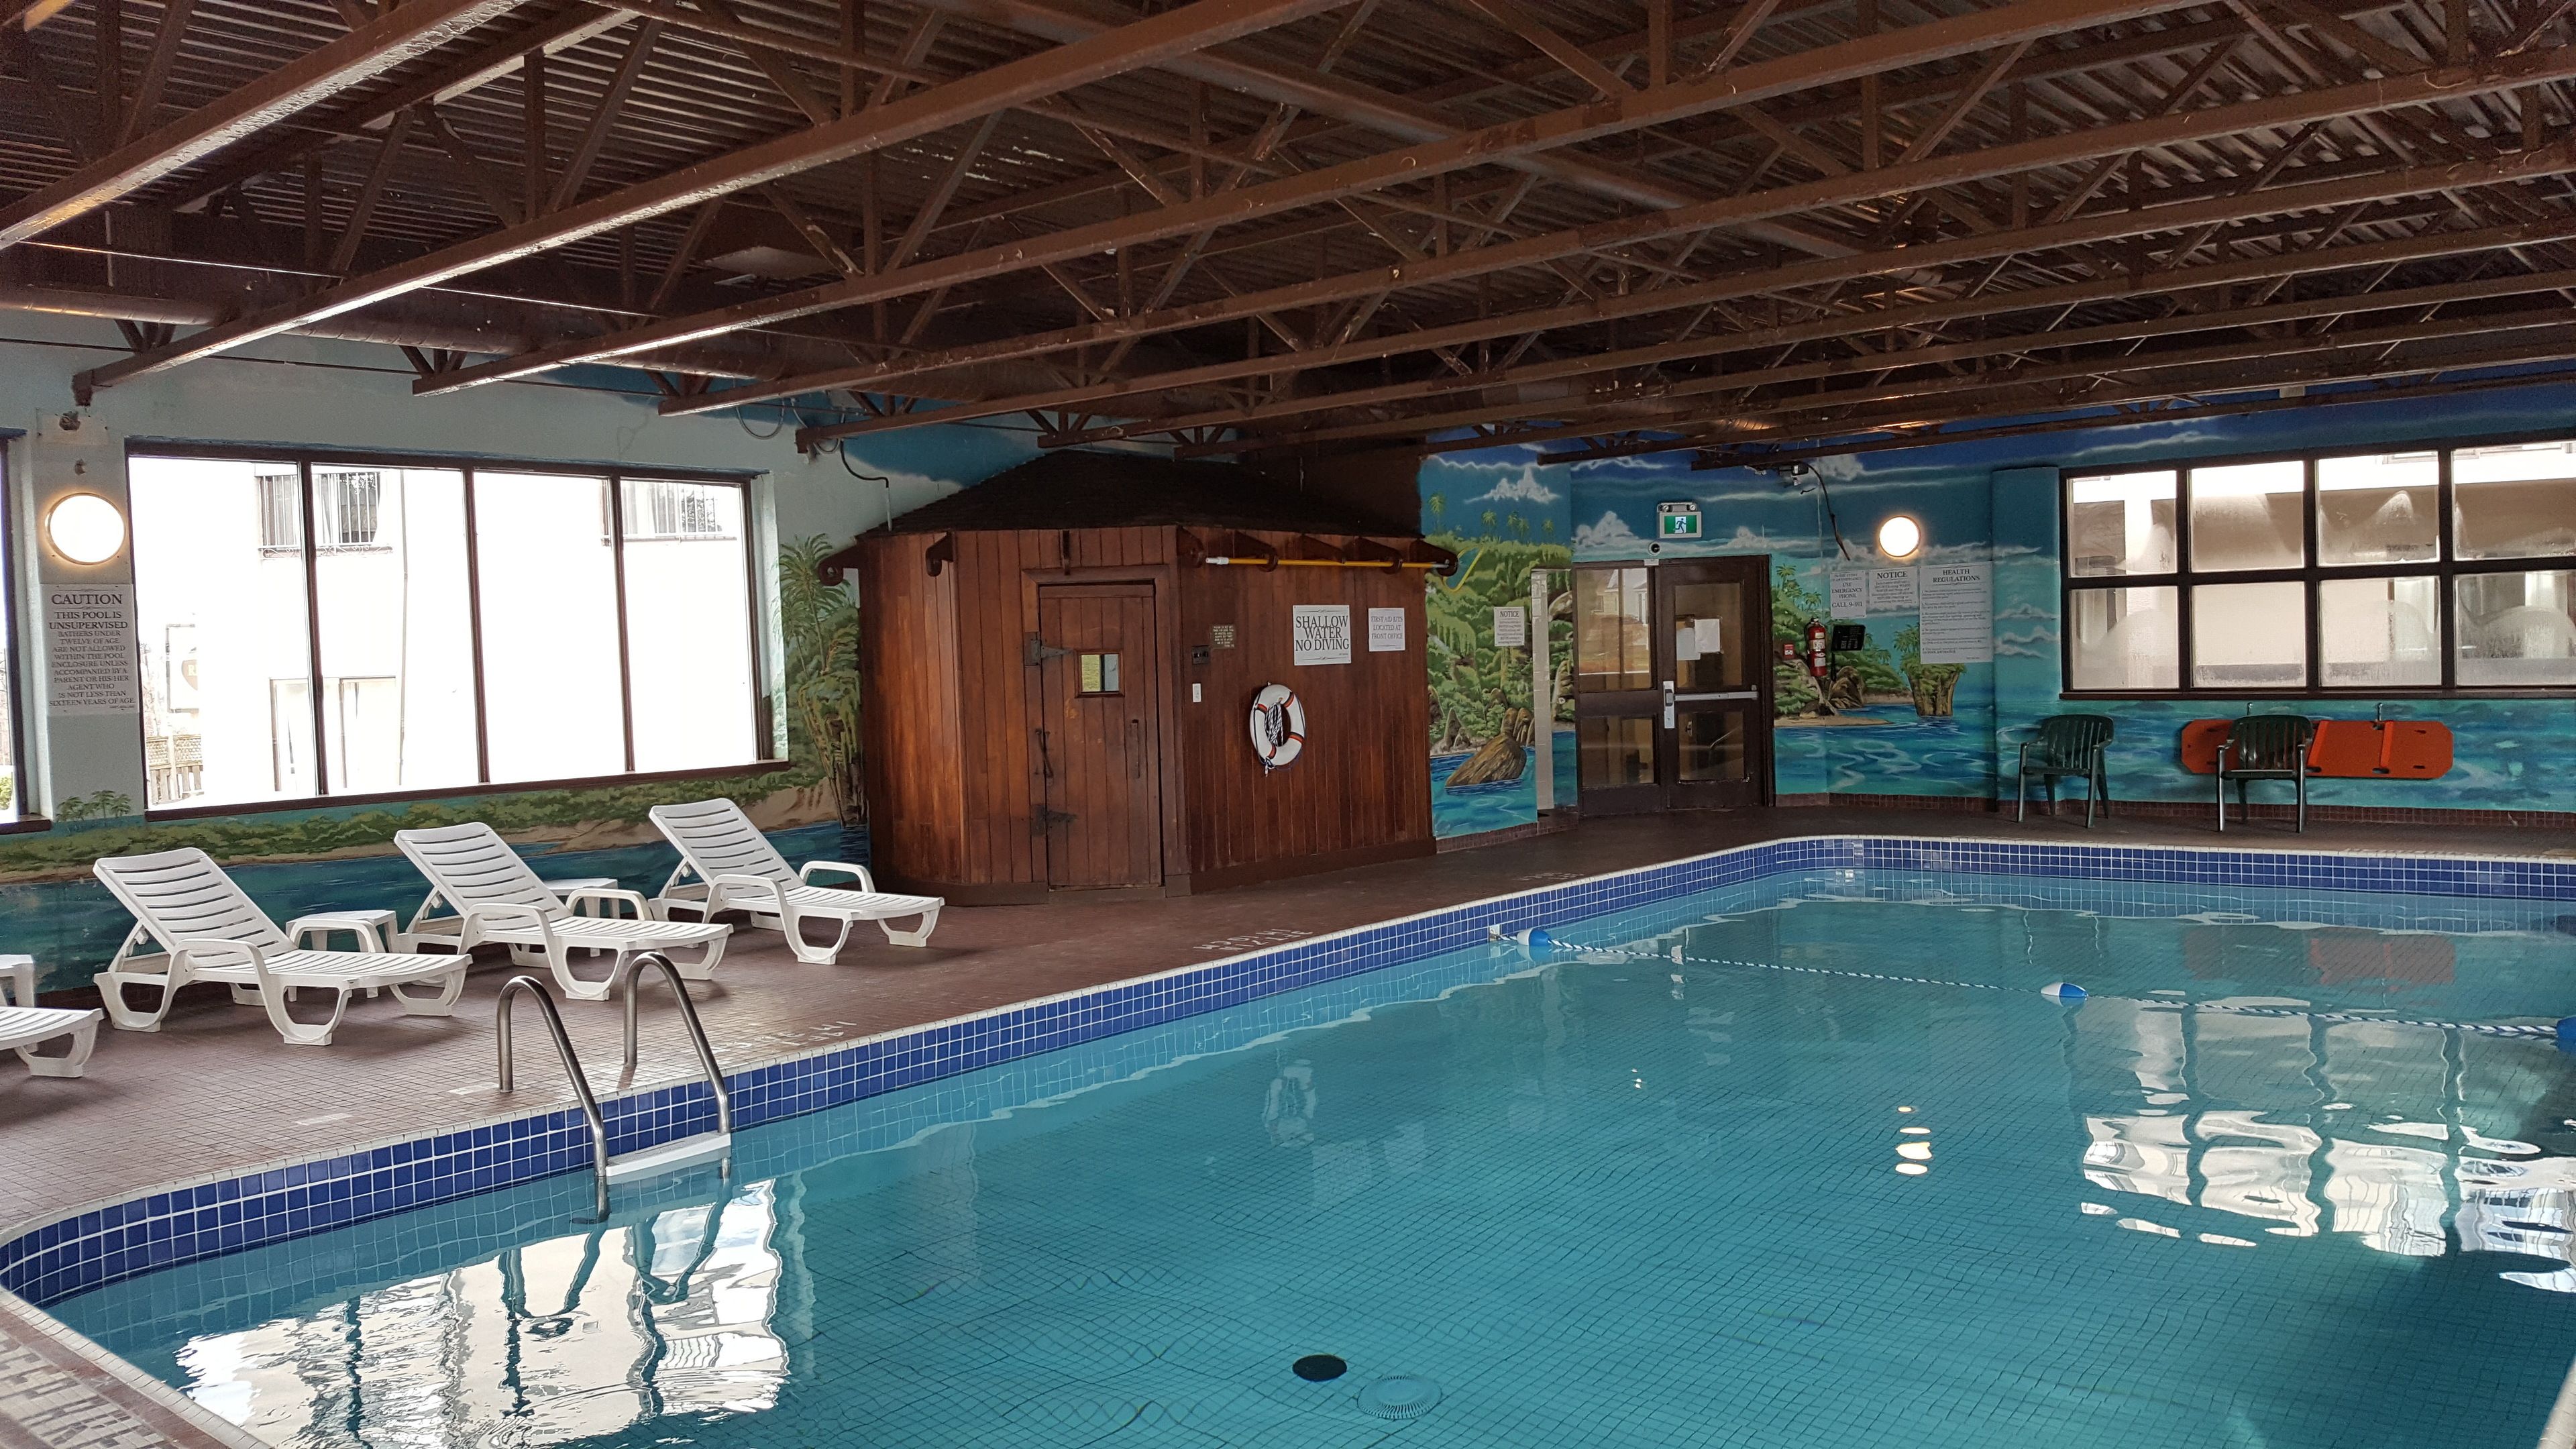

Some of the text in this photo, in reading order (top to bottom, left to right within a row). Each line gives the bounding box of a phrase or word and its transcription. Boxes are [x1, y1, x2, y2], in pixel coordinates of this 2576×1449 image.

[1877, 572, 1908, 580] NOTICE
[51, 594, 123, 605] CAUTION
[54, 610, 122, 619] THIS POOL IS
[49, 621, 128, 629] UNSUPERVISED
[1295, 615, 1348, 628] SHALLOW
[1303, 627, 1342, 639] WATER
[1295, 638, 1350, 651] NO DIVING
